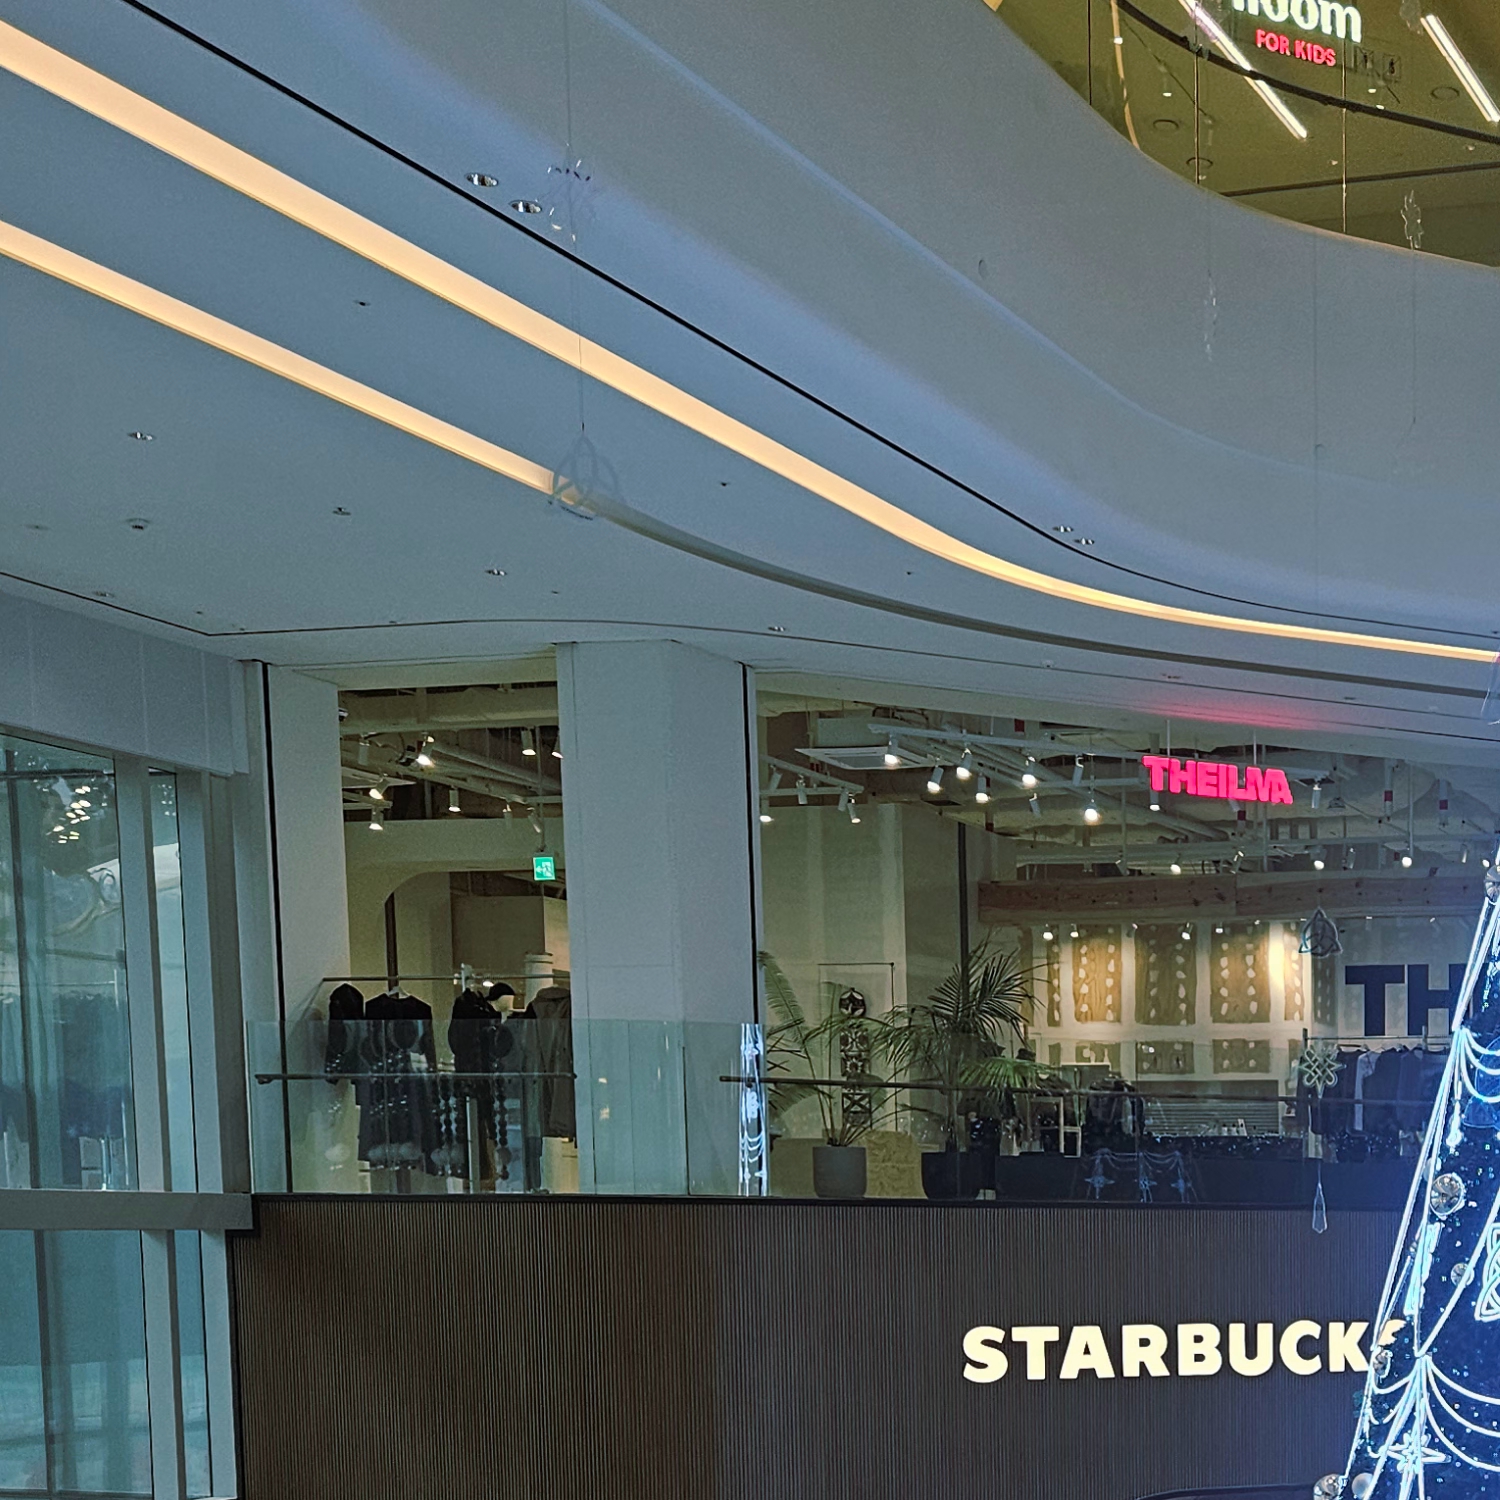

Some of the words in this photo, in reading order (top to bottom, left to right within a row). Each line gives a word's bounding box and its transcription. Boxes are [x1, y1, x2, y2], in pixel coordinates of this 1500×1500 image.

[1233, 0, 1362, 43] oom
[1255, 28, 1291, 56] FOR
[1294, 39, 1337, 67] KIDS
